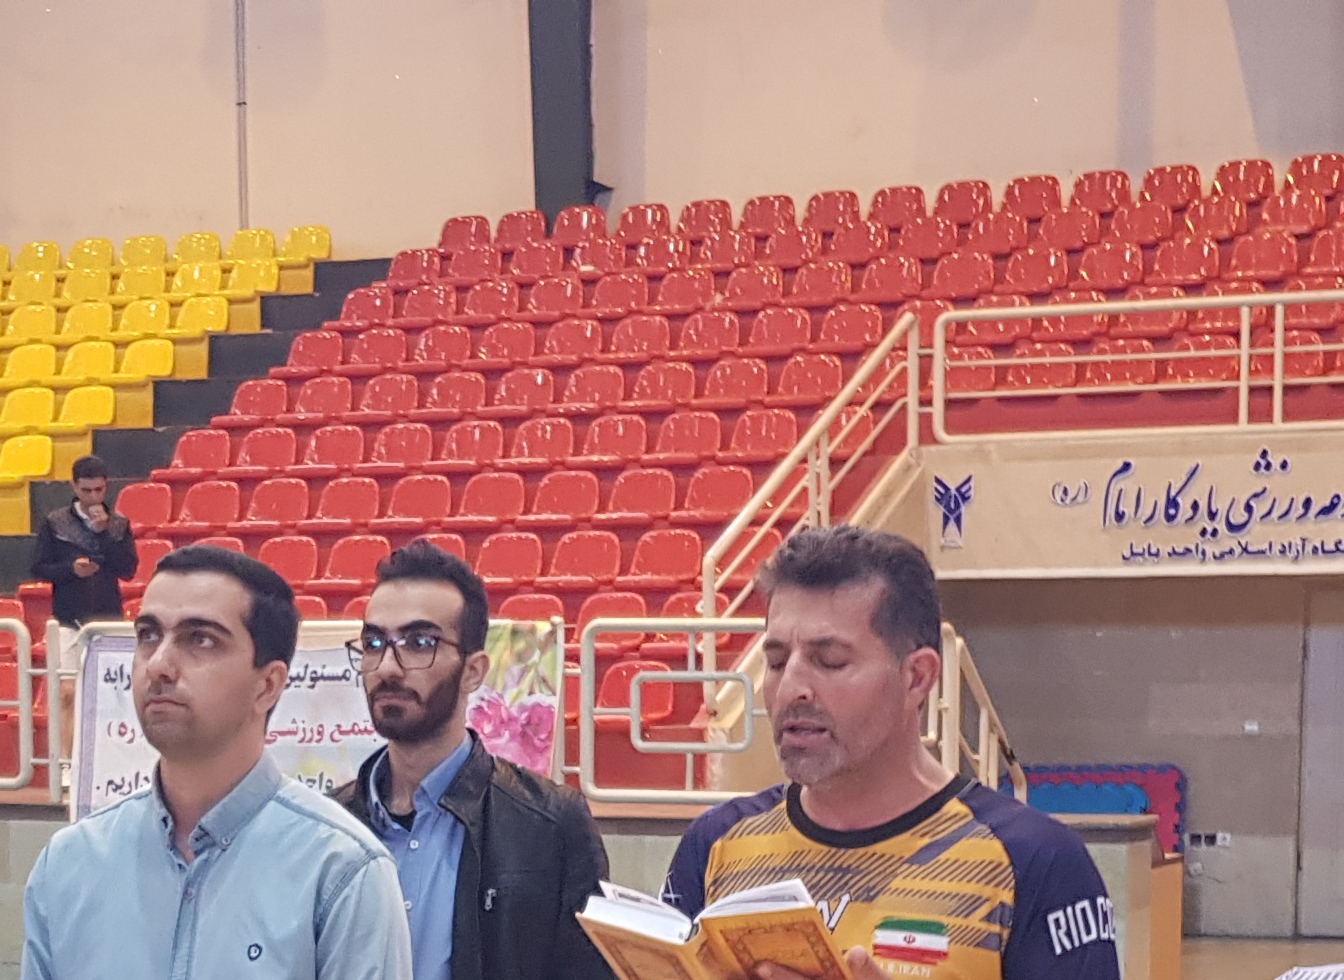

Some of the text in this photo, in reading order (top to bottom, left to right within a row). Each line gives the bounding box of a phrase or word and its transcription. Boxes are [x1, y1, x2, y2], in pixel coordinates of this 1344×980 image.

[1103, 460, 1143, 530] امام
[1224, 448, 1313, 534] ورزشی
[1121, 541, 1161, 562] بابل
[1167, 542, 1207, 563] واحد
[1212, 539, 1273, 560] اسلامی
[1278, 537, 1307, 561] آزاد
[264, 718, 325, 745] ورزشی
